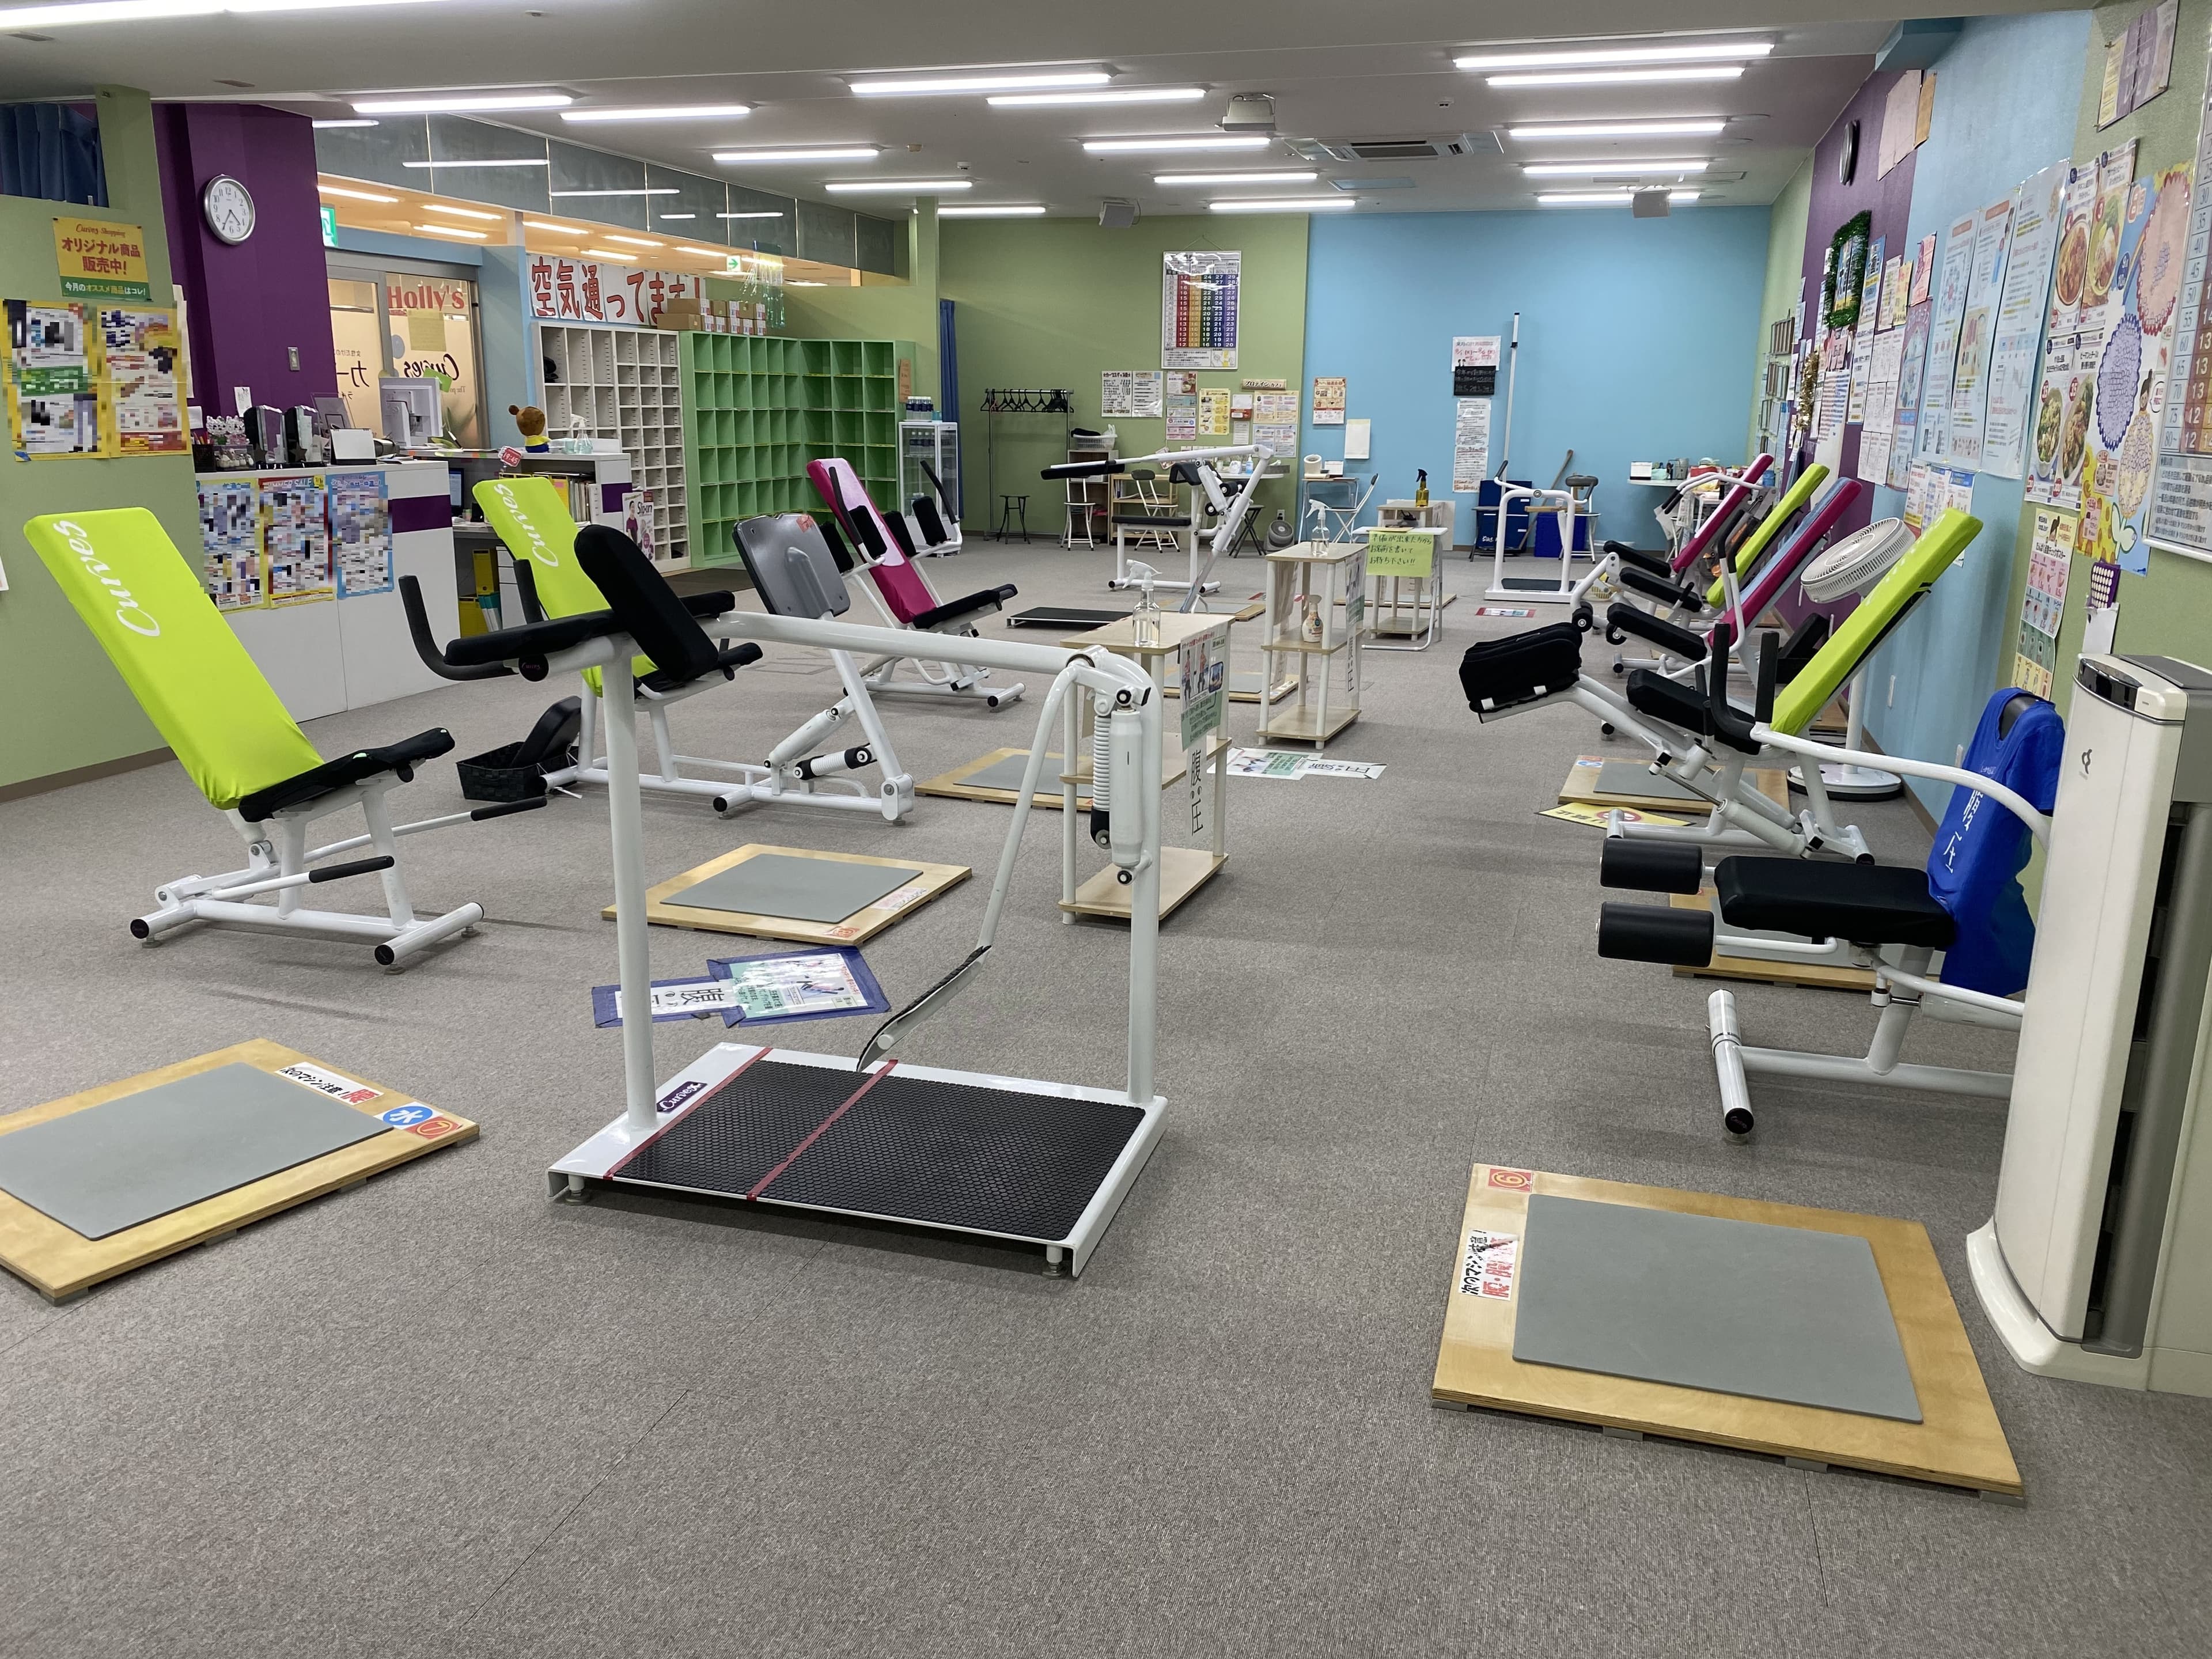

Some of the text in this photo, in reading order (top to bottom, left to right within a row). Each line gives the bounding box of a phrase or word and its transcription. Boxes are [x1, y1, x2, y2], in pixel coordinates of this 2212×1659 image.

[2200, 187, 2209, 204] 30
[2197, 212, 2206, 230] 35
[62, 237, 141, 258] オリジナル商品
[2194, 237, 2203, 253] 40
[82, 256, 127, 275] 販売中!
[2191, 262, 2200, 278] 45
[387, 285, 464, 312] Holly's
[2187, 286, 2196, 304] 50
[2183, 311, 2192, 328] 55
[2180, 332, 2212, 351] 60 13
[2176, 357, 2208, 376] 65 13
[2173, 382, 2205, 400] 70 13
[2169, 408, 2178, 423] 75
[2189, 407, 2200, 424] 12
[2185, 432, 2197, 448] 12
[494, 483, 559, 567] Curves
[53, 520, 160, 637] Curves
[659, 1083, 701, 1111] Curves
[389, 1109, 423, 1123] 水
